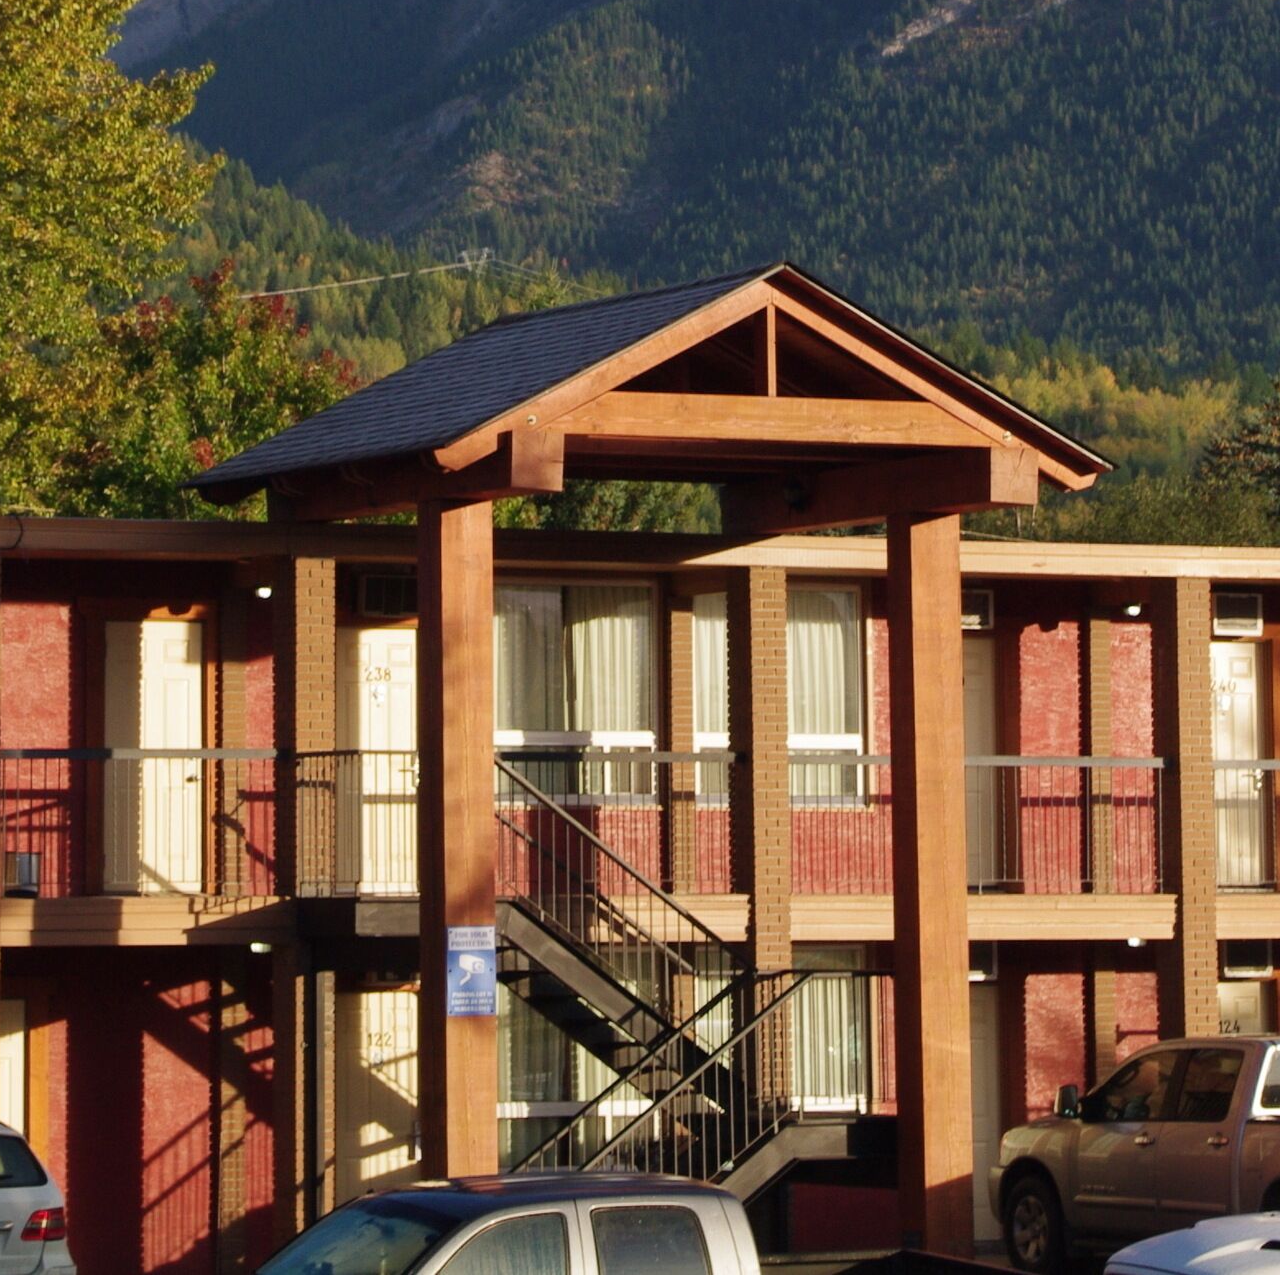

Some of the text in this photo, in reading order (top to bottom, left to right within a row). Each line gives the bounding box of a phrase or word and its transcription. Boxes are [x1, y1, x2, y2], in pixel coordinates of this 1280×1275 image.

[364, 667, 392, 682] 238
[1219, 1019, 1240, 1034] 124
[367, 1032, 392, 1047] 122
